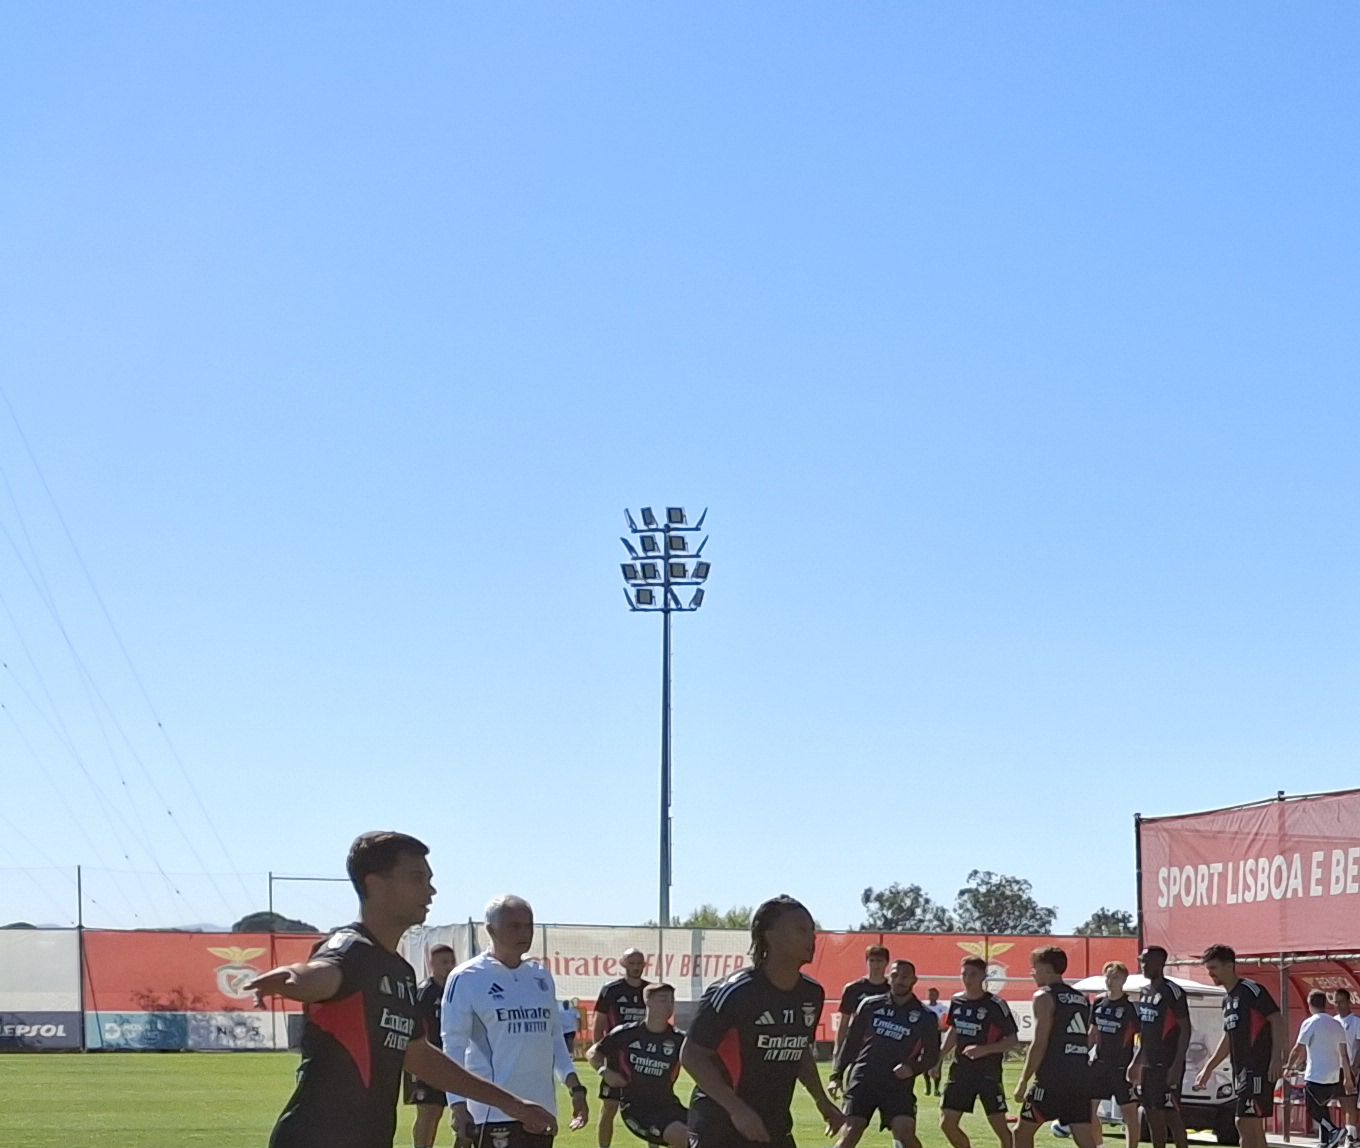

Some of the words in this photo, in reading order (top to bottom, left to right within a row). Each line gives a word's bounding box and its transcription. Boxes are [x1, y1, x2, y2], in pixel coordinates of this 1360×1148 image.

[1158, 862, 1222, 908] SPORT
[1226, 853, 1303, 905] LISBOA
[1310, 851, 1324, 897] E
[496, 1005, 551, 1021] Emirate
[783, 1008, 793, 1024] 71
[0, 1025, 67, 1036] EPSOL
